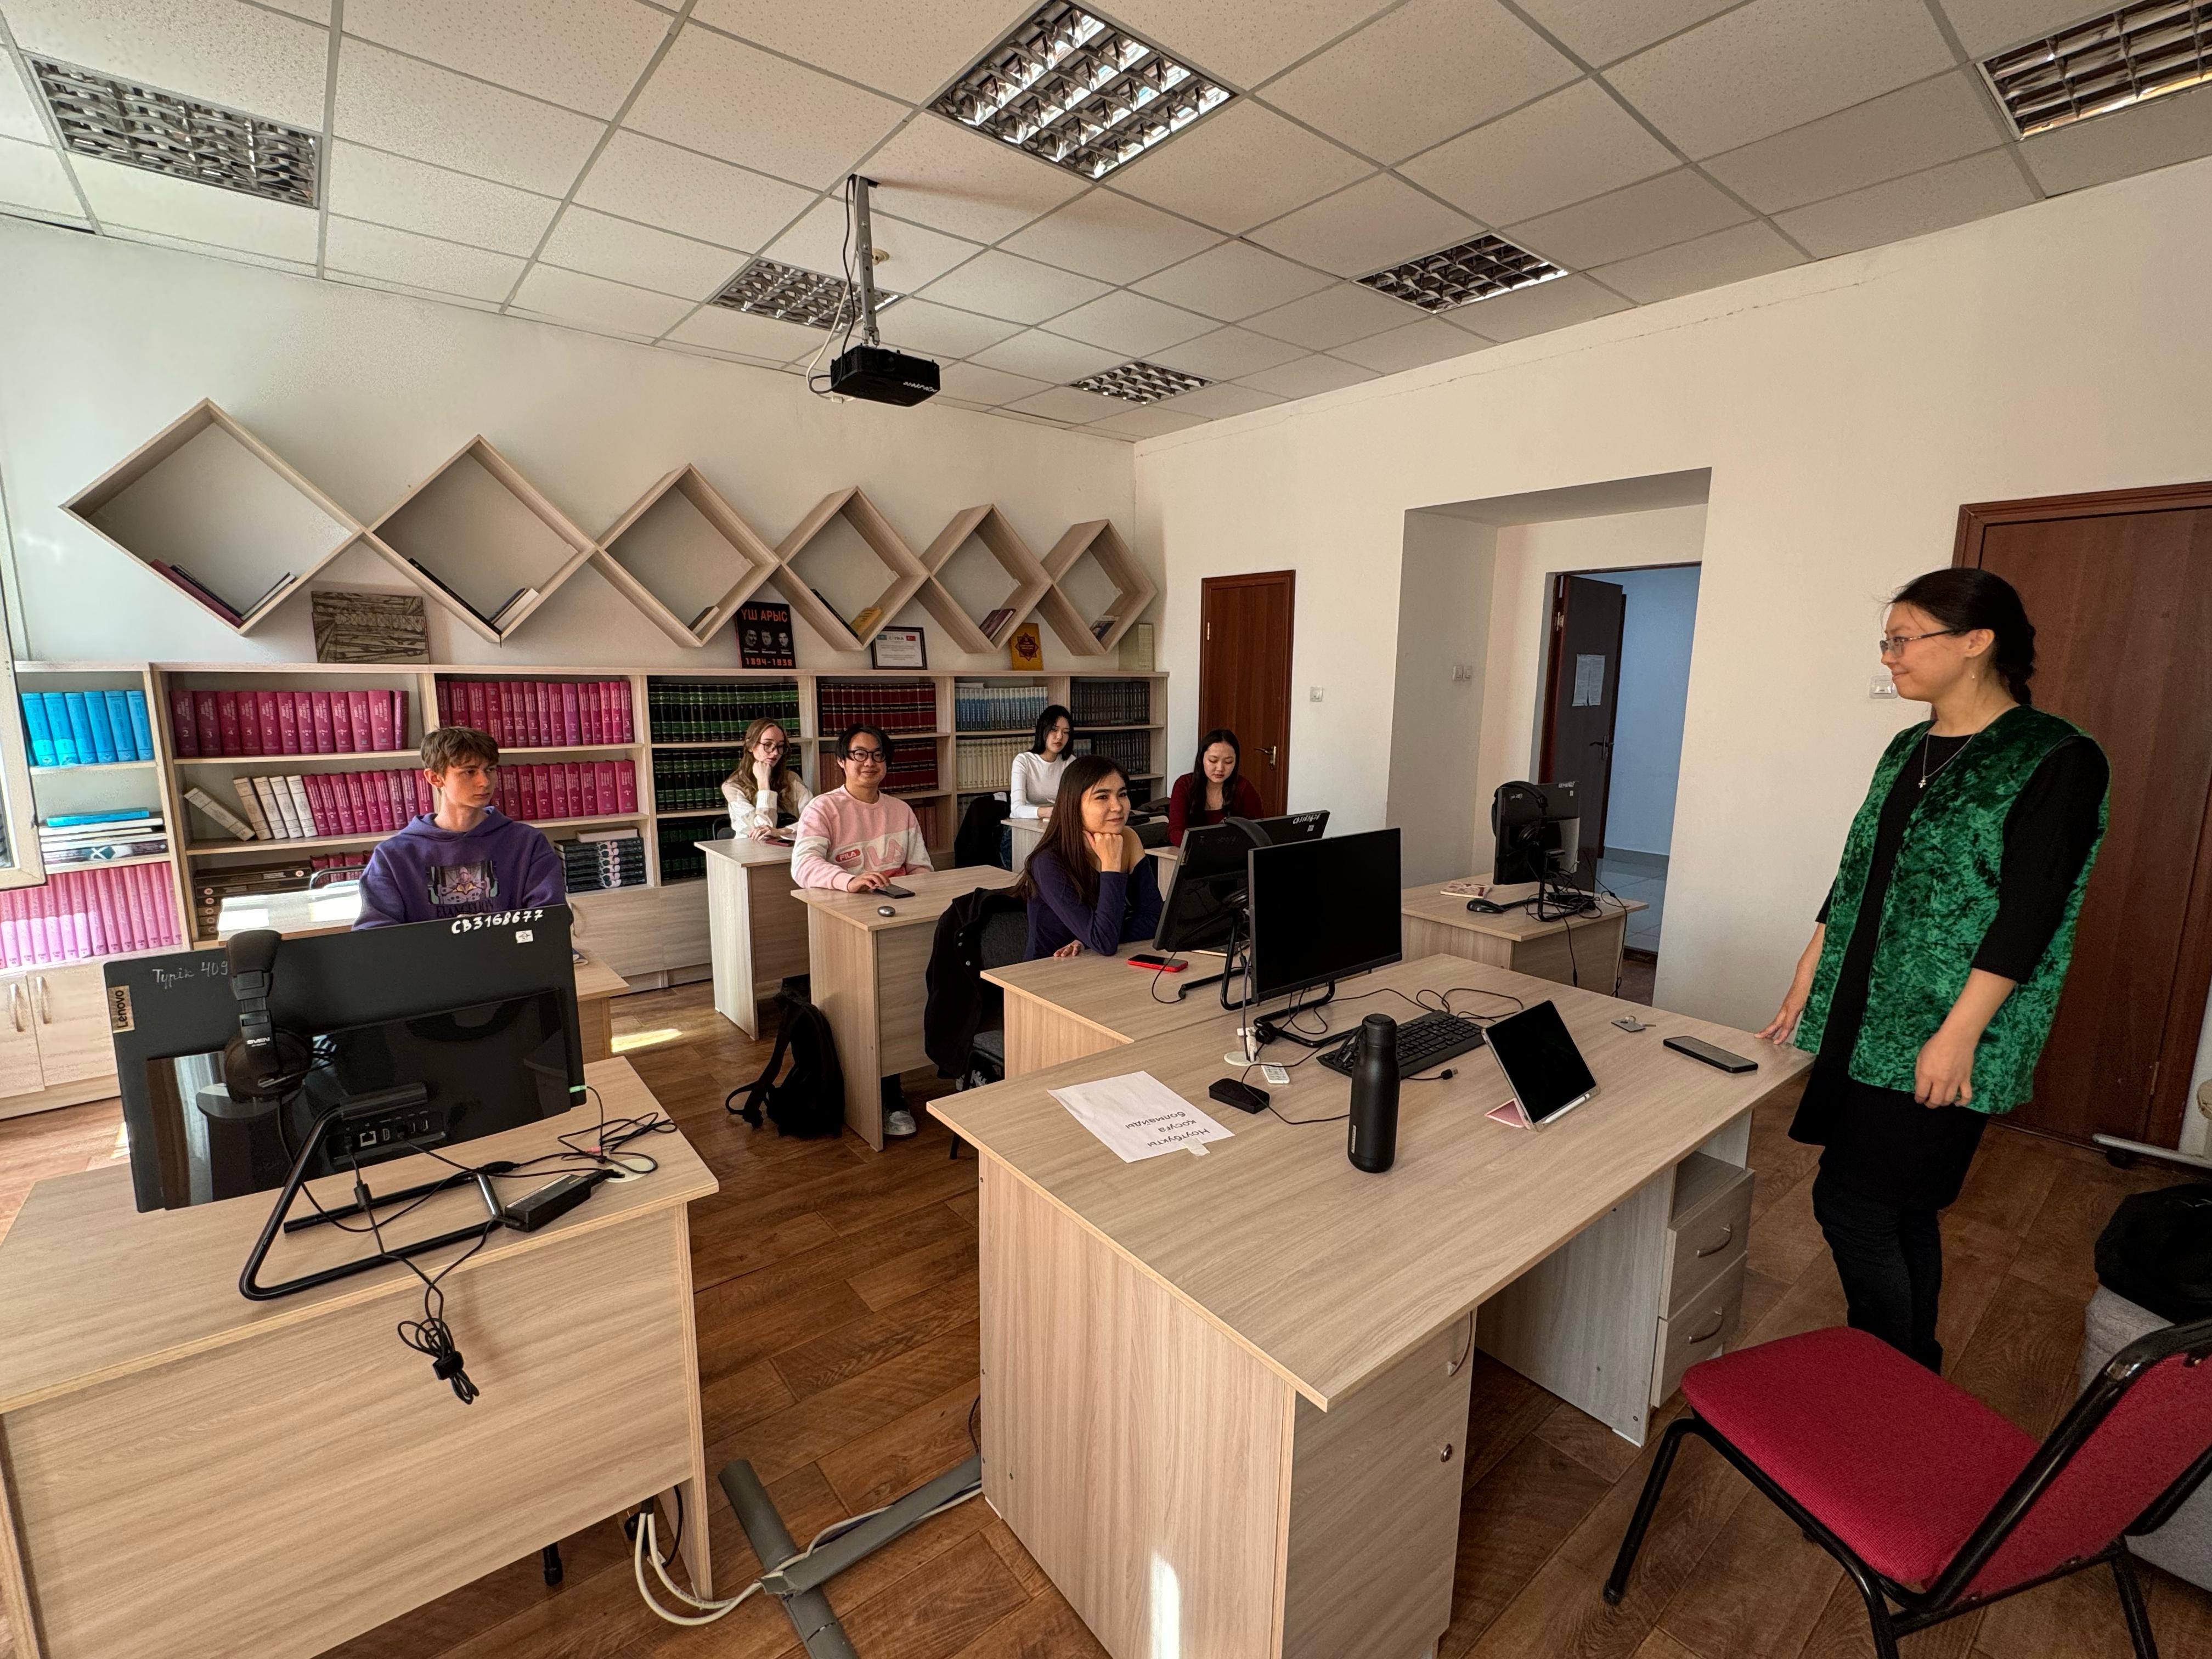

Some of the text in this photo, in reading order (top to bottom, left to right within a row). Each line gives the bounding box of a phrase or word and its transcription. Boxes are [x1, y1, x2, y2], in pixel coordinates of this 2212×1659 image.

[760, 610, 788, 622] АРЫС
[839, 851, 856, 861] FILA
[115, 990, 128, 1028] Lenovo
[1125, 1111, 1186, 1129] болмайды
[1147, 1128, 1210, 1148] Ноутбукты
